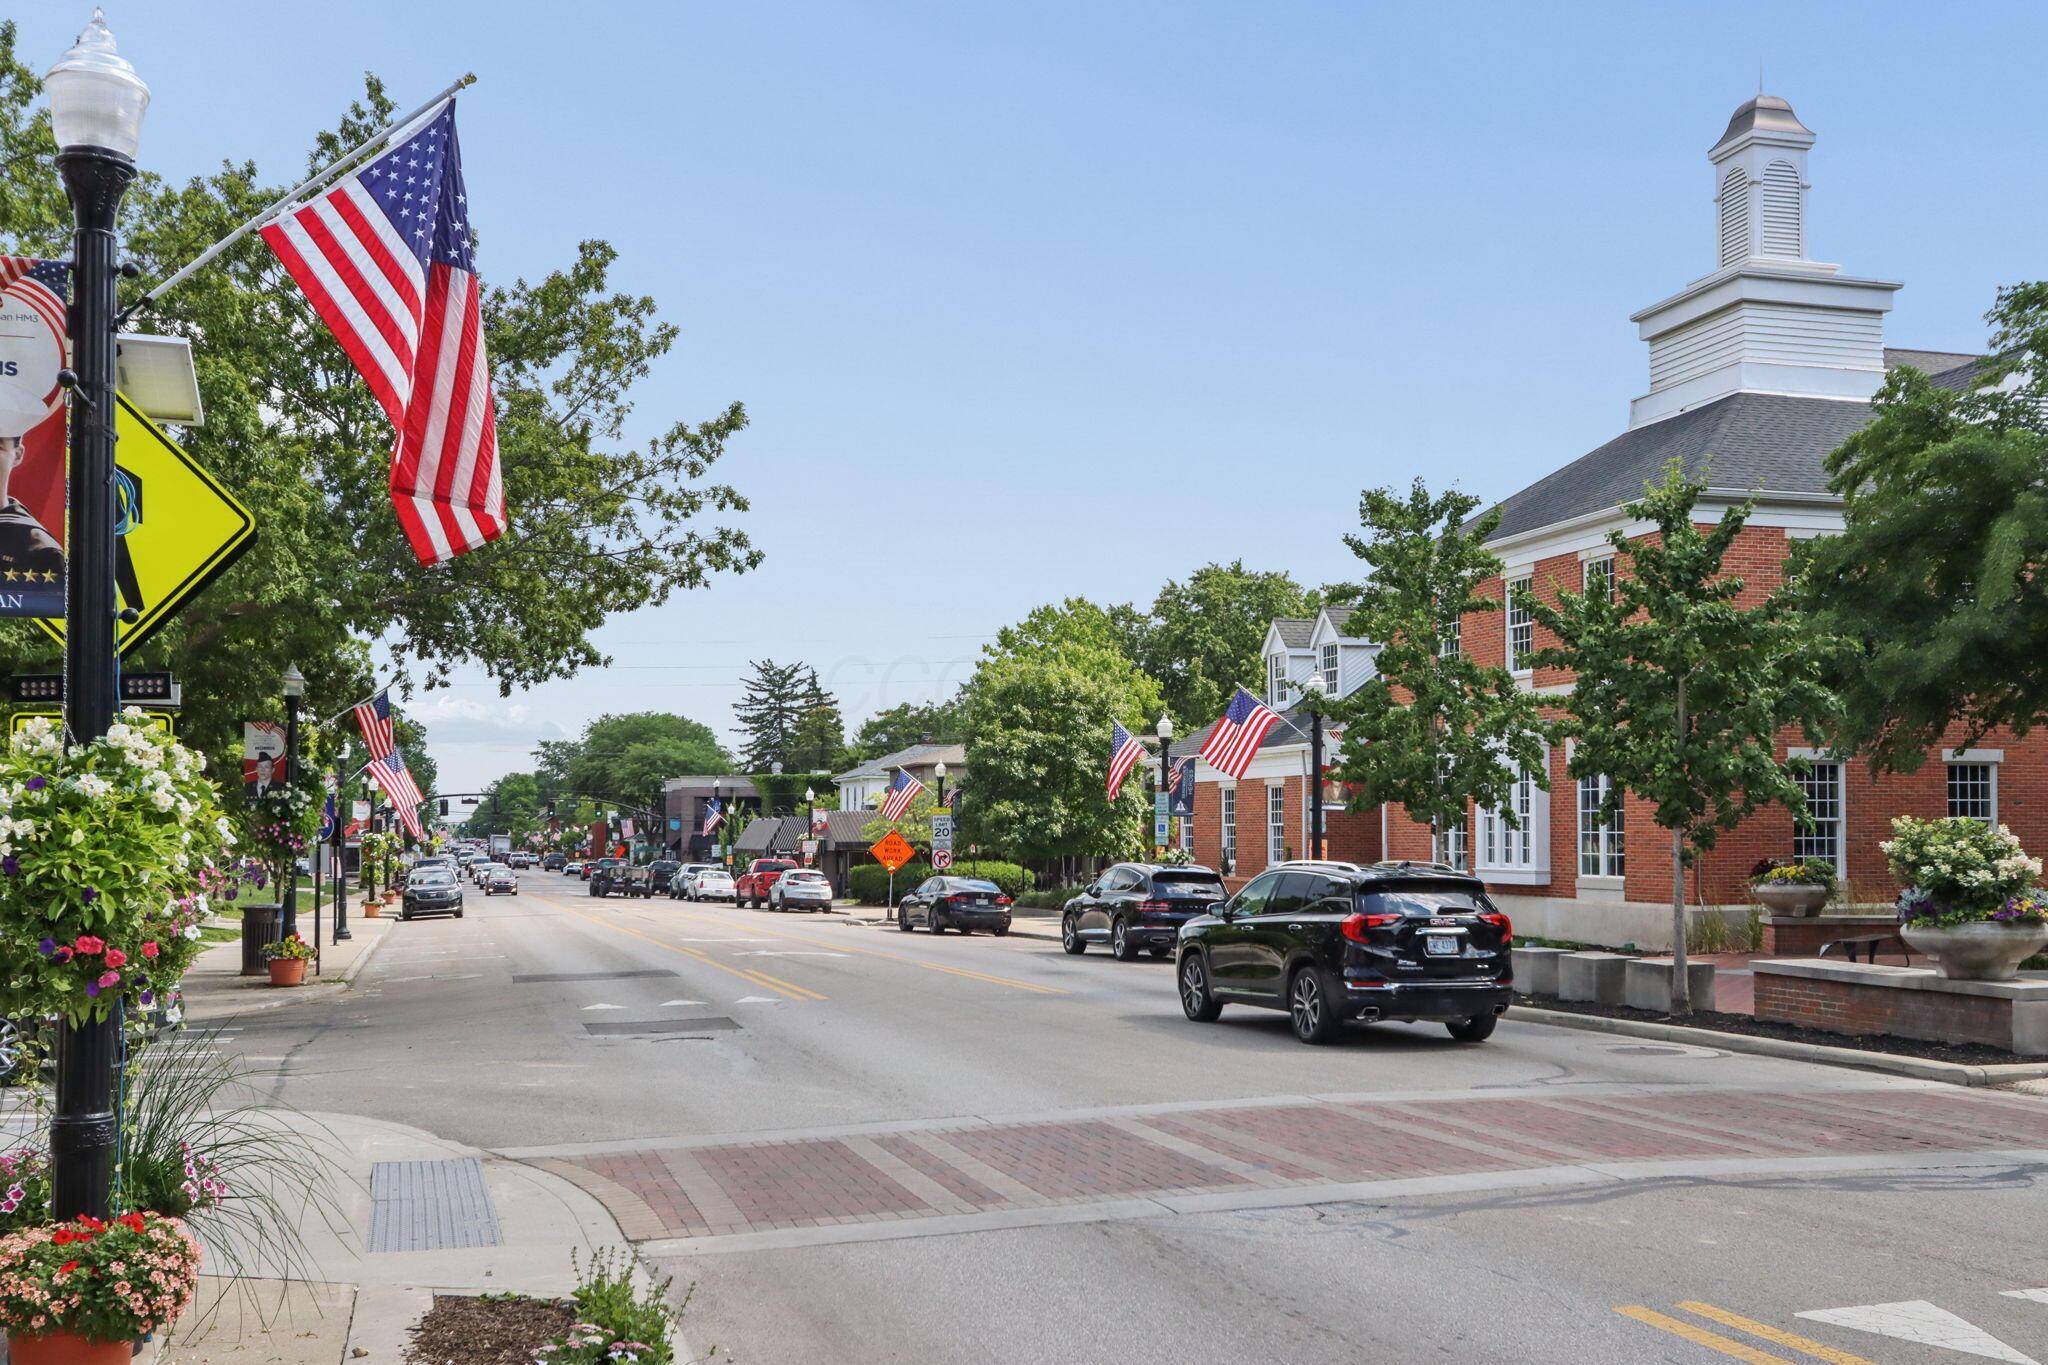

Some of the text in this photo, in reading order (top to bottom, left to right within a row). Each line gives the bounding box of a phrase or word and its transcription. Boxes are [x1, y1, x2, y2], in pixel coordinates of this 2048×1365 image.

[934, 828, 950, 837] 20
[885, 839, 902, 847] ROAD
[1429, 918, 1456, 926] GMC
